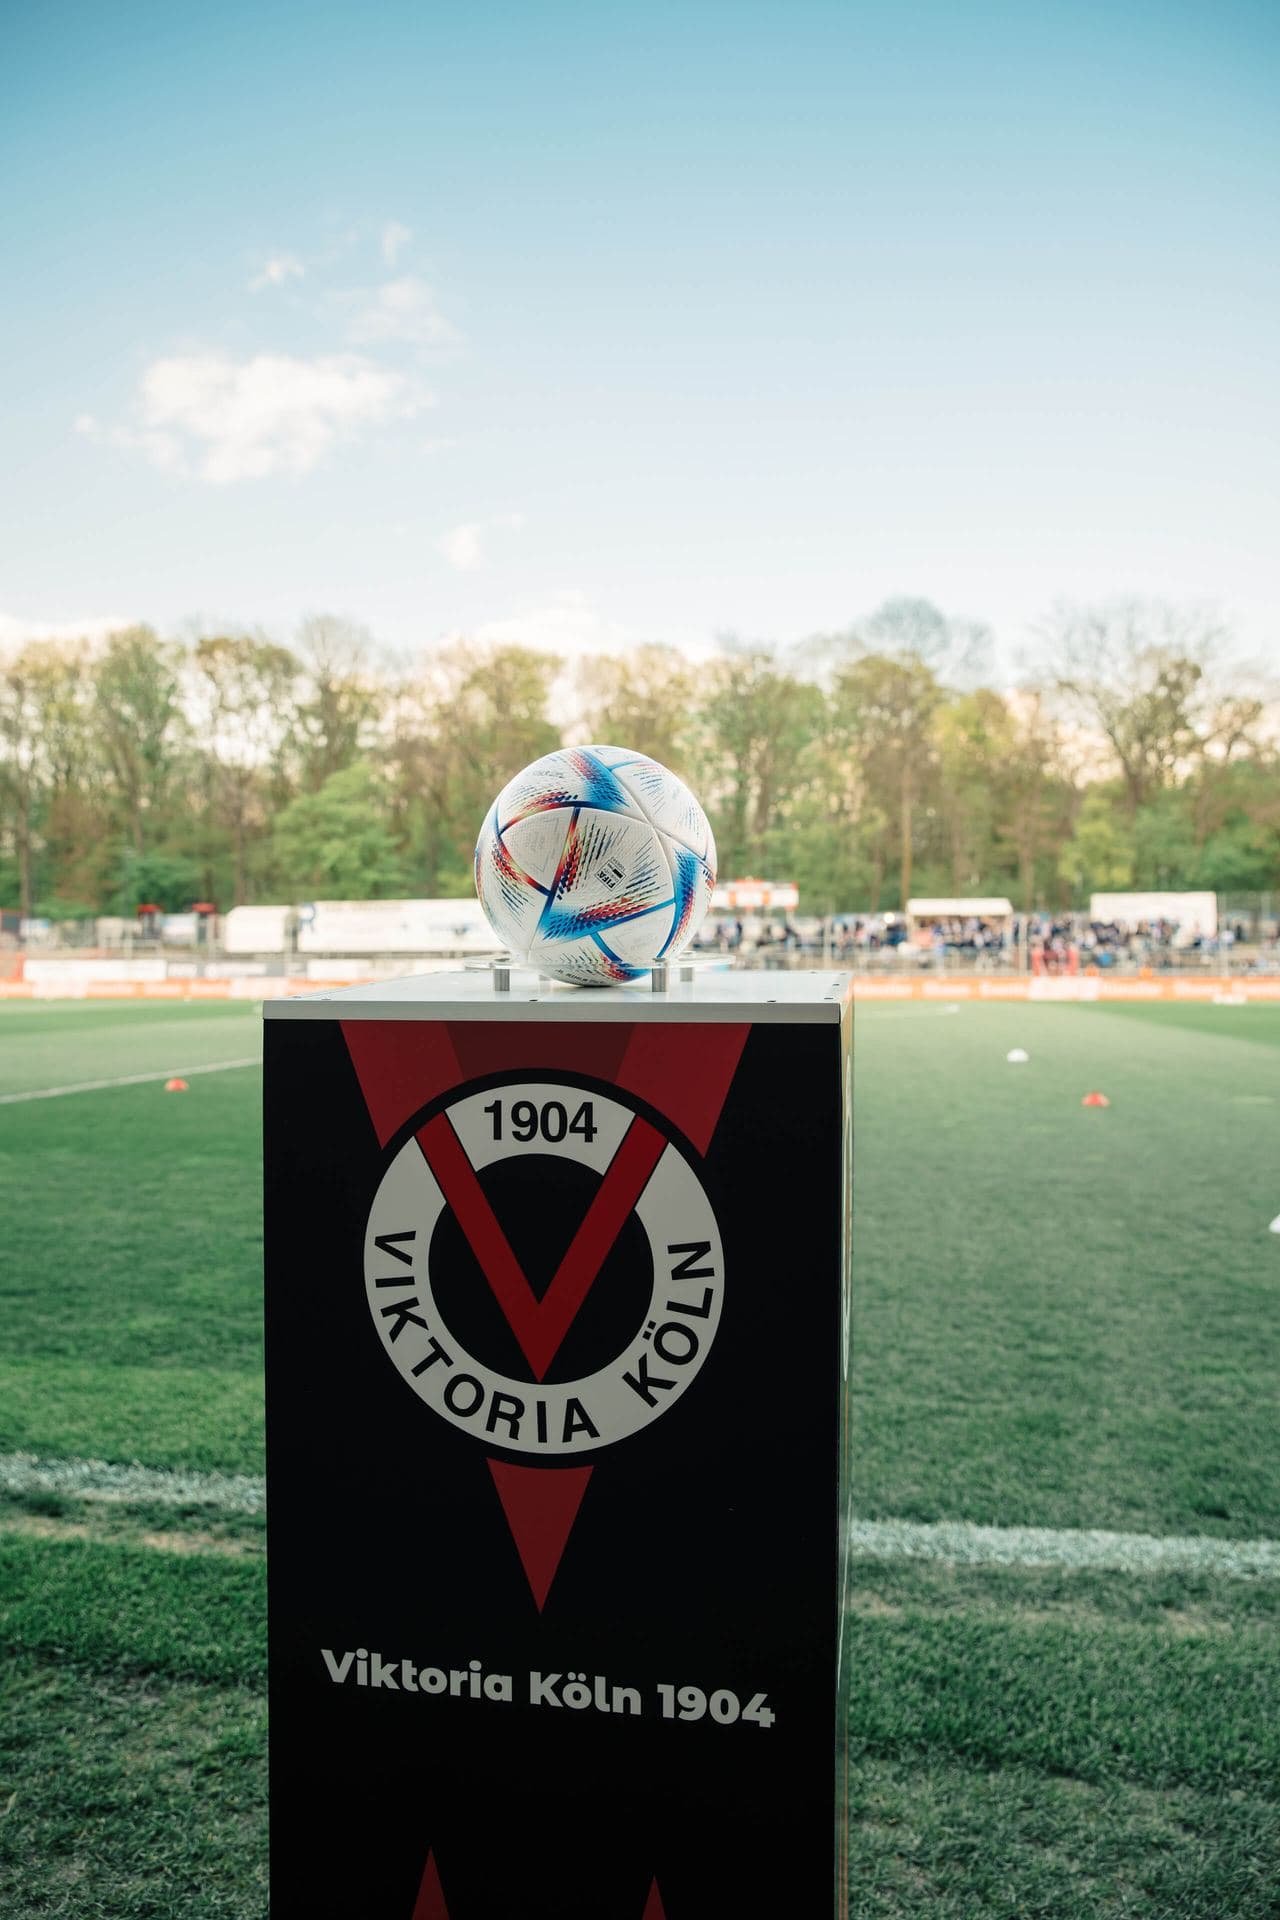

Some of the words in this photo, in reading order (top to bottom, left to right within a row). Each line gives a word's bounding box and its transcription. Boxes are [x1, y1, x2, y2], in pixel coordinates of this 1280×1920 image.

[483, 1099, 598, 1143] 1904
[374, 1230, 600, 1444] VIKTORIA
[622, 1240, 715, 1408] KÖLN
[320, 1647, 513, 1702] Viktoria
[529, 1671, 642, 1715] Köln
[657, 1684, 776, 1728] 1904
